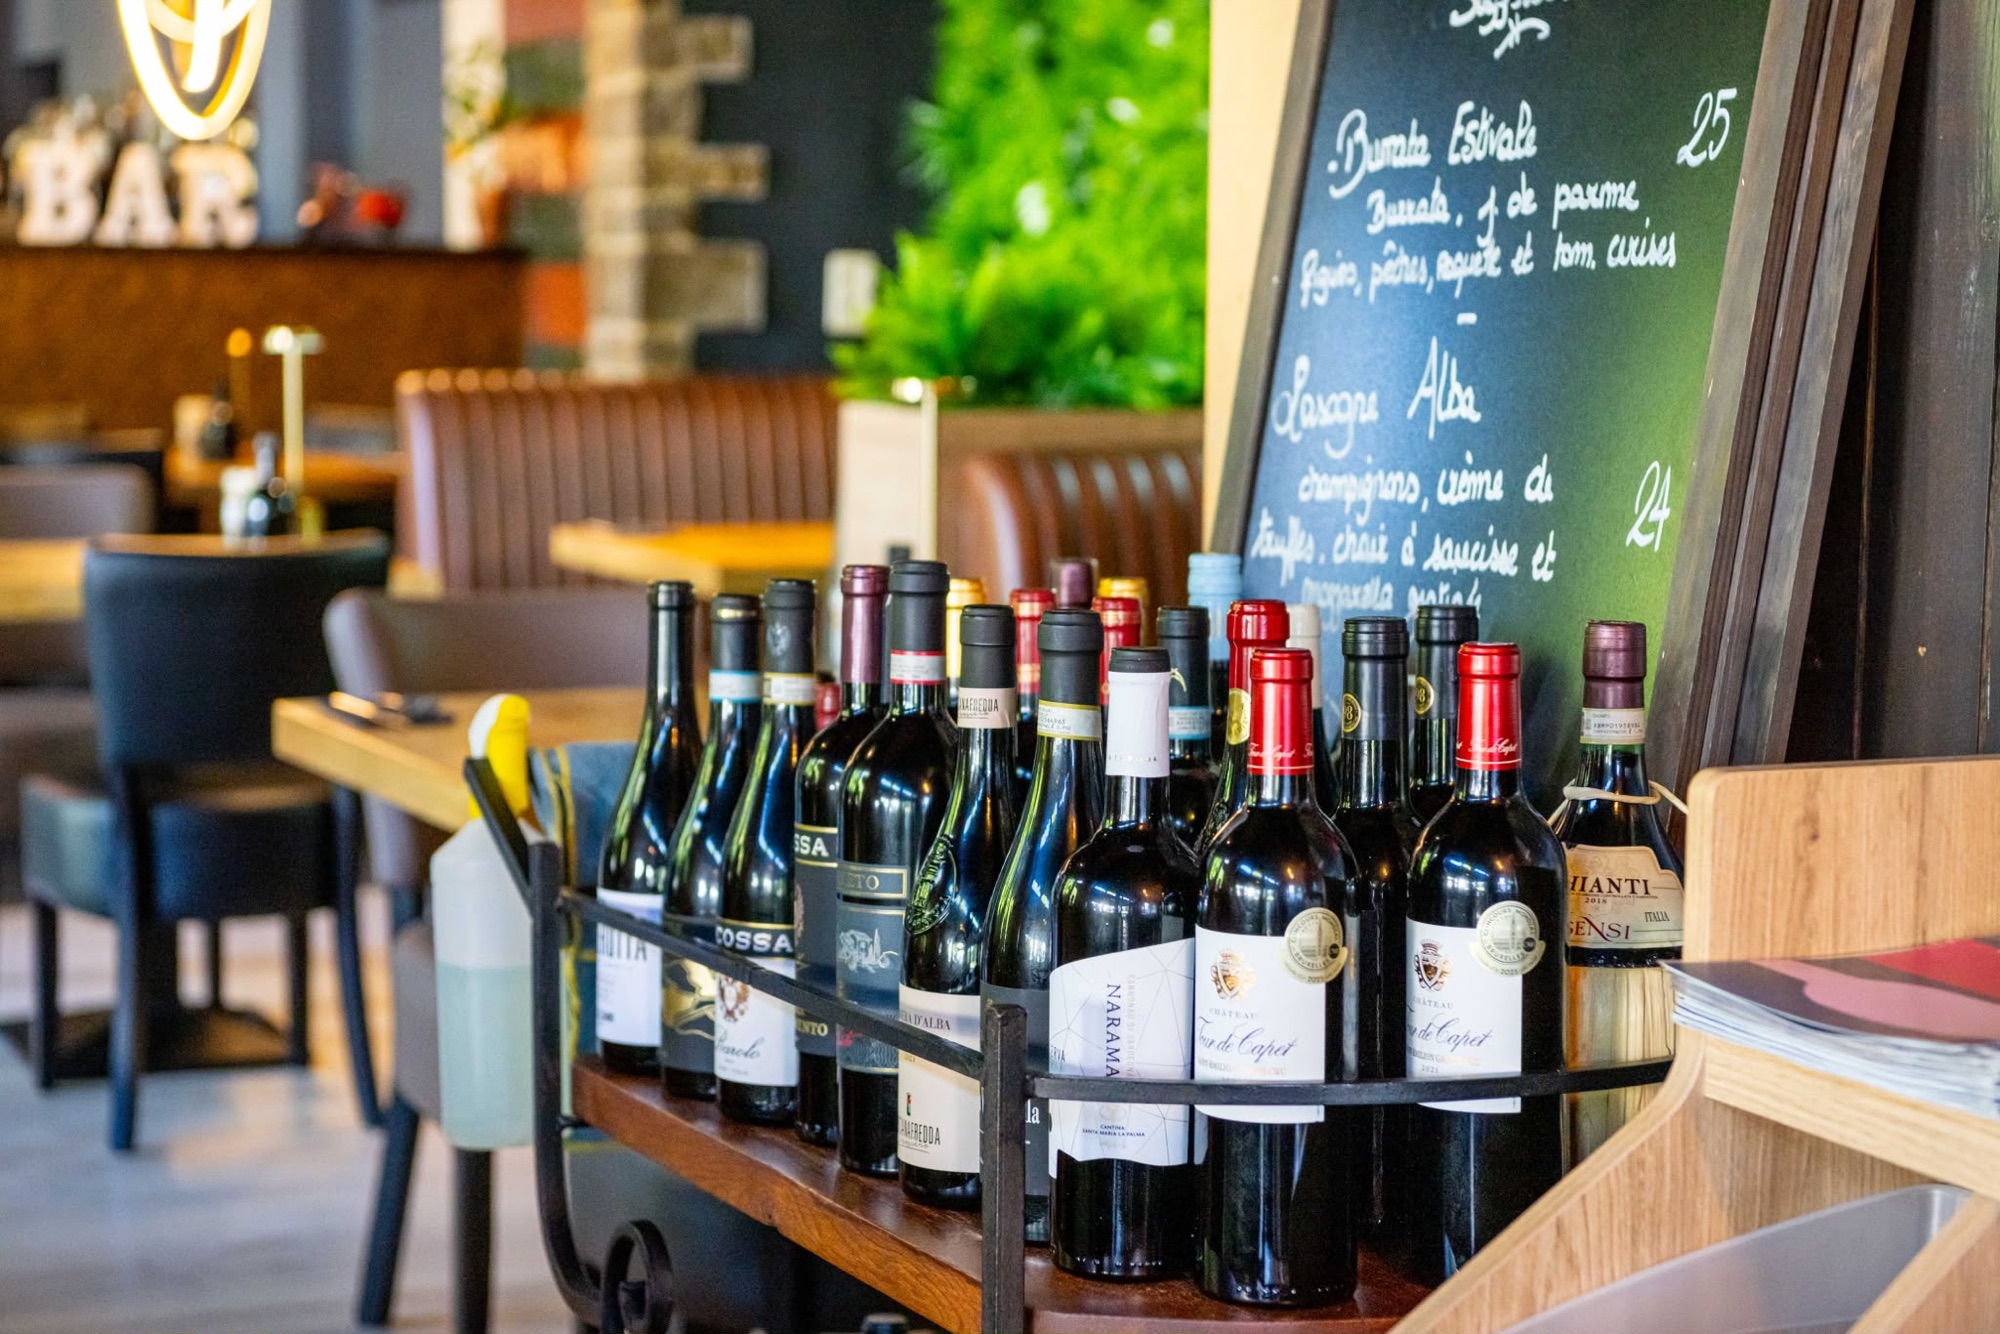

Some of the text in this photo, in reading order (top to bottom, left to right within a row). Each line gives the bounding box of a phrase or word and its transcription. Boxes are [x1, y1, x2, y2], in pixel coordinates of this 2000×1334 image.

[1448, 99, 1538, 165] Estivale
[1676, 87, 1738, 167] 25
[12, 142, 259, 247] BAR
[1507, 171, 1537, 219] de
[1552, 179, 1640, 230] parme
[1511, 230, 1534, 276] et
[1606, 217, 1677, 268] cerises
[1270, 335, 1482, 460] Lasagne Alba
[1524, 453, 1554, 503] de
[1625, 460, 1672, 553] 24
[1401, 520, 1417, 566] à
[1422, 524, 1519, 577] saucisse
[1531, 530, 1556, 582] et
[715, 926, 794, 954] COSSA
[1644, 911, 1670, 922] ITALIA
[914, 1014, 951, 1031] D'ALBA
[1105, 983, 1121, 1078] NARAMA
[1216, 1033, 1235, 1053] de
[1233, 1021, 1298, 1064] Capet
[1431, 1012, 1494, 1053] Capet
